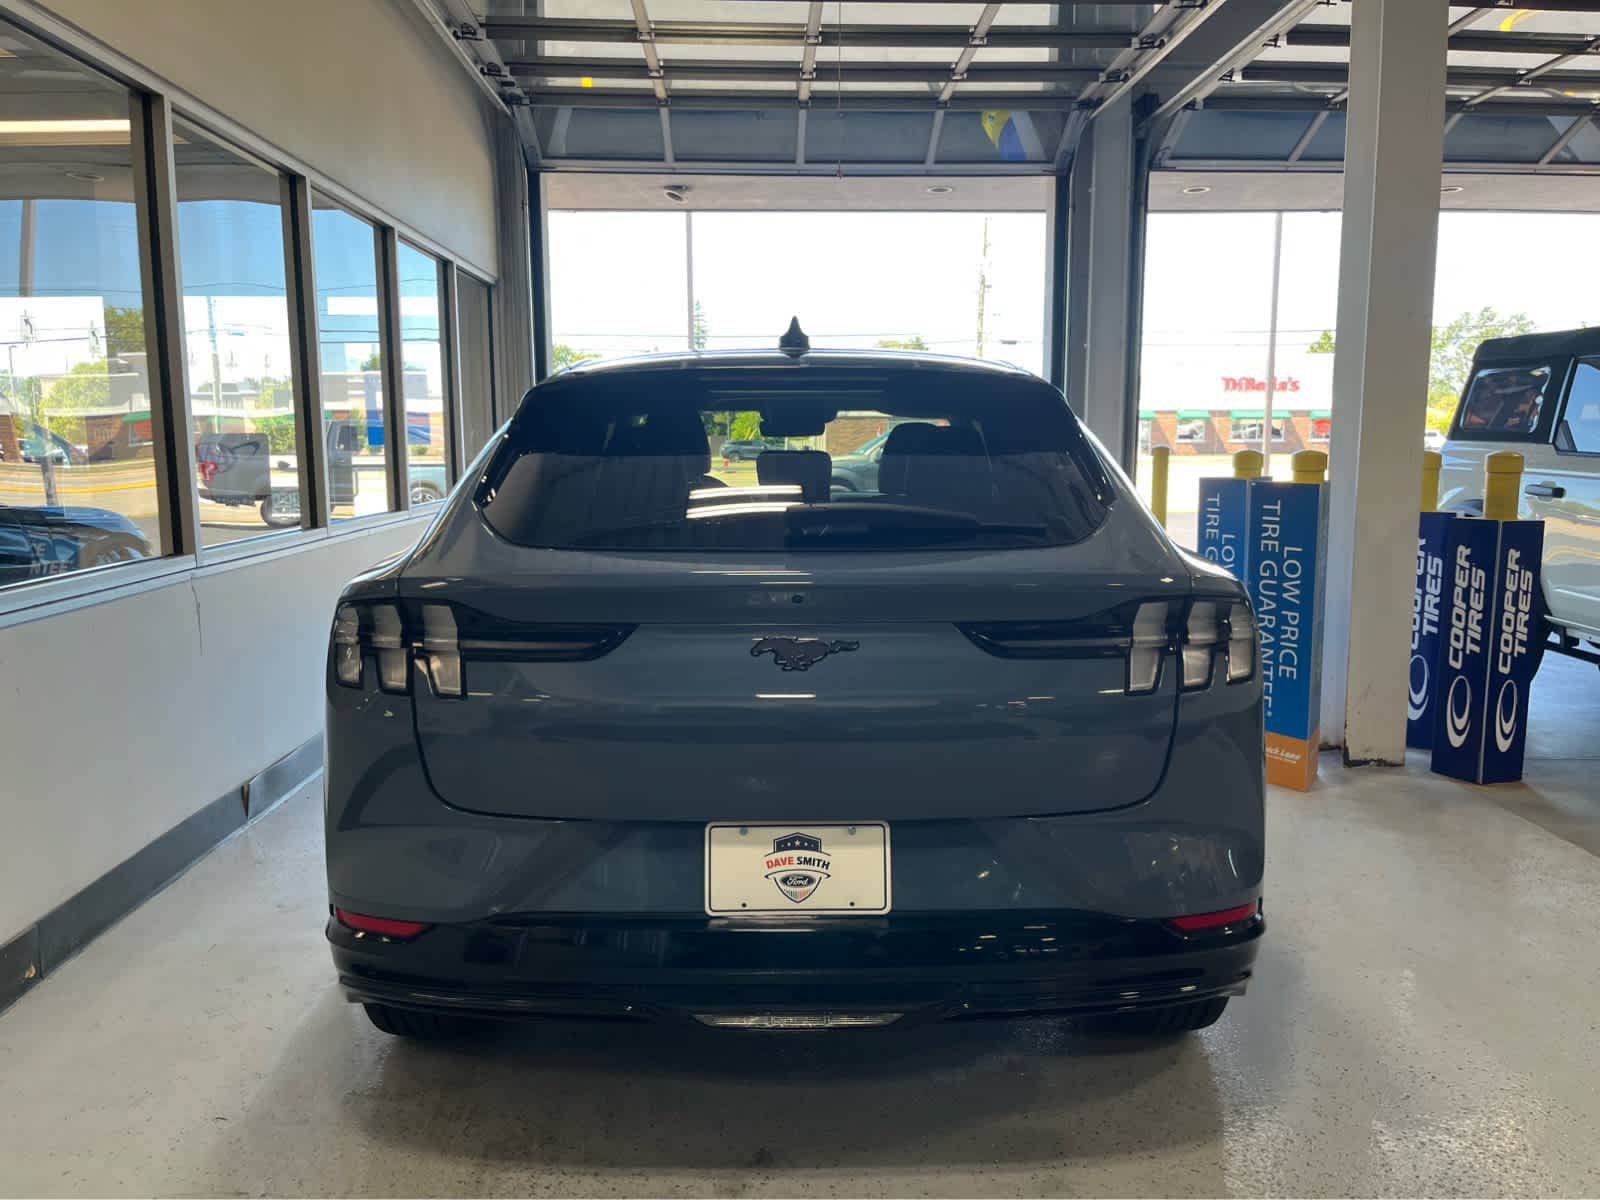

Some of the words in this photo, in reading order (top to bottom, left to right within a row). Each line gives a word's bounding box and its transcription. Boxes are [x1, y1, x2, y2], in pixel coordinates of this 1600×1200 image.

[1205, 492, 1220, 540] TIRE
[1261, 499, 1281, 553] TIRE
[1222, 534, 1236, 569] LO
[1282, 546, 1303, 604] LOW
[1422, 554, 1443, 636] TIRES
[1449, 544, 1472, 670] COOPER
[1466, 566, 1486, 655] TIRES
[1498, 548, 1521, 675] COOPER
[1514, 568, 1533, 658] TIRES
[1279, 610, 1301, 681] PRICE
[766, 856, 795, 869] DAVE
[796, 856, 830, 870] SMITH
[786, 877, 808, 886] Ford
